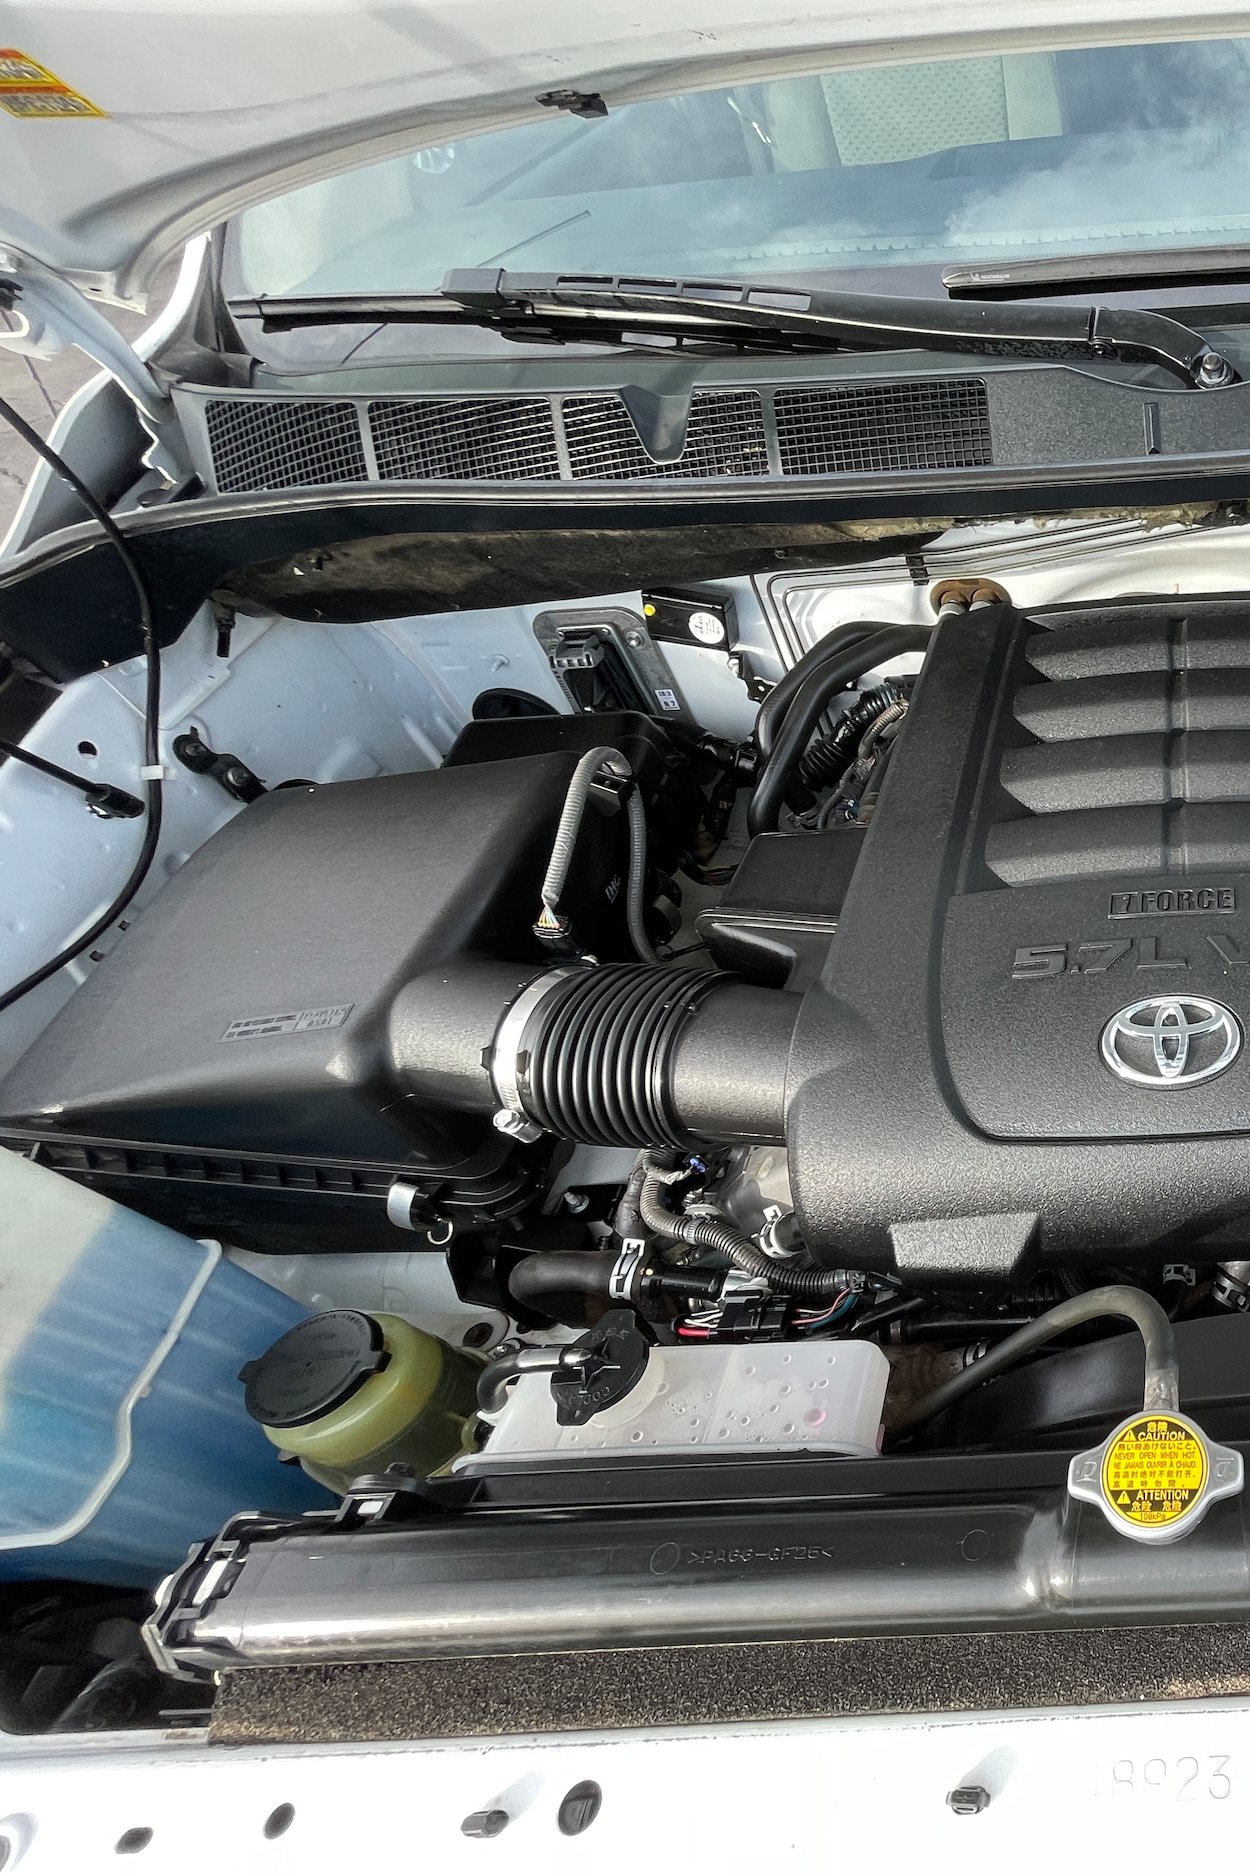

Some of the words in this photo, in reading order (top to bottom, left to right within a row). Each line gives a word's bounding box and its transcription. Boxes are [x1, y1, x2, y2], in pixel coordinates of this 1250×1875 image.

[1011, 936, 1192, 981] 5.7L
[1137, 1431, 1186, 1441] CAUTION
[1160, 1451, 1178, 1459] WHEN
[1182, 1451, 1195, 1459] HOT
[1146, 1461, 1167, 1469] OUVRIR
[1136, 1489, 1190, 1500] ATTENTION
[1140, 1512, 1167, 1520] 108kPa
